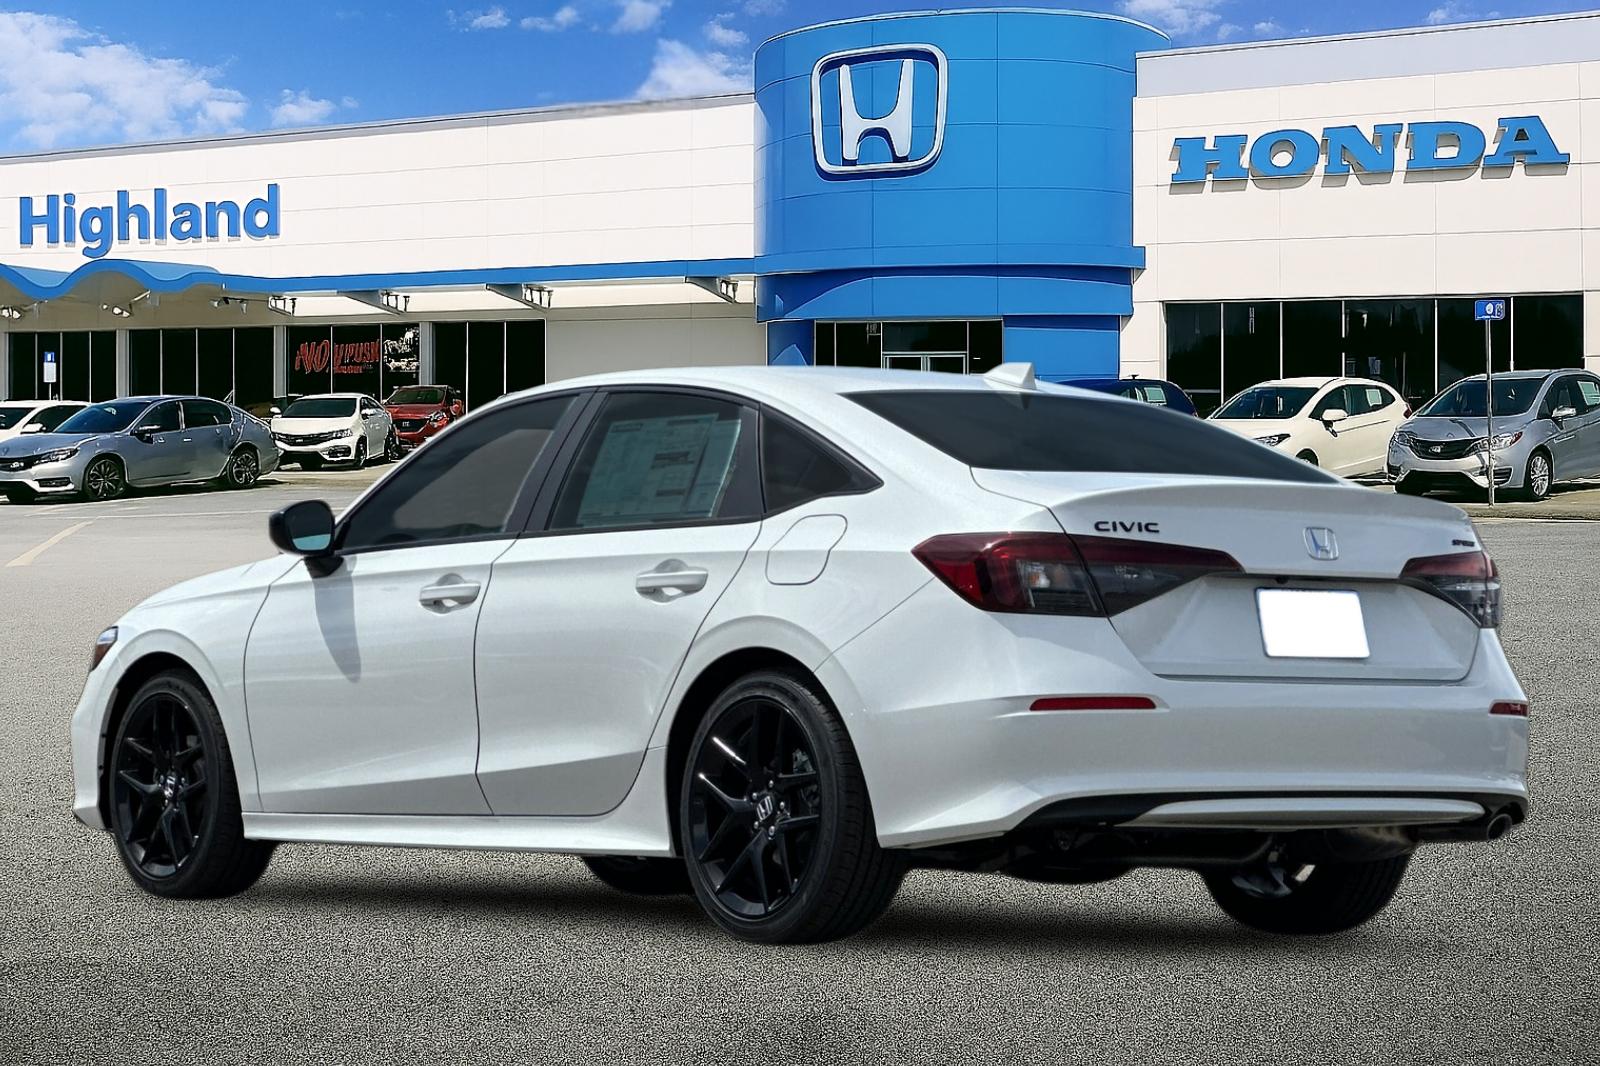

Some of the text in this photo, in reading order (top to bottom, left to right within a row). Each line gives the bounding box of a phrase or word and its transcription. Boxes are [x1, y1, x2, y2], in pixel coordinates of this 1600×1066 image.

[1171, 115, 1571, 184] HONDA
[19, 182, 281, 258] Highland
[1094, 520, 1160, 533] CIVIC
